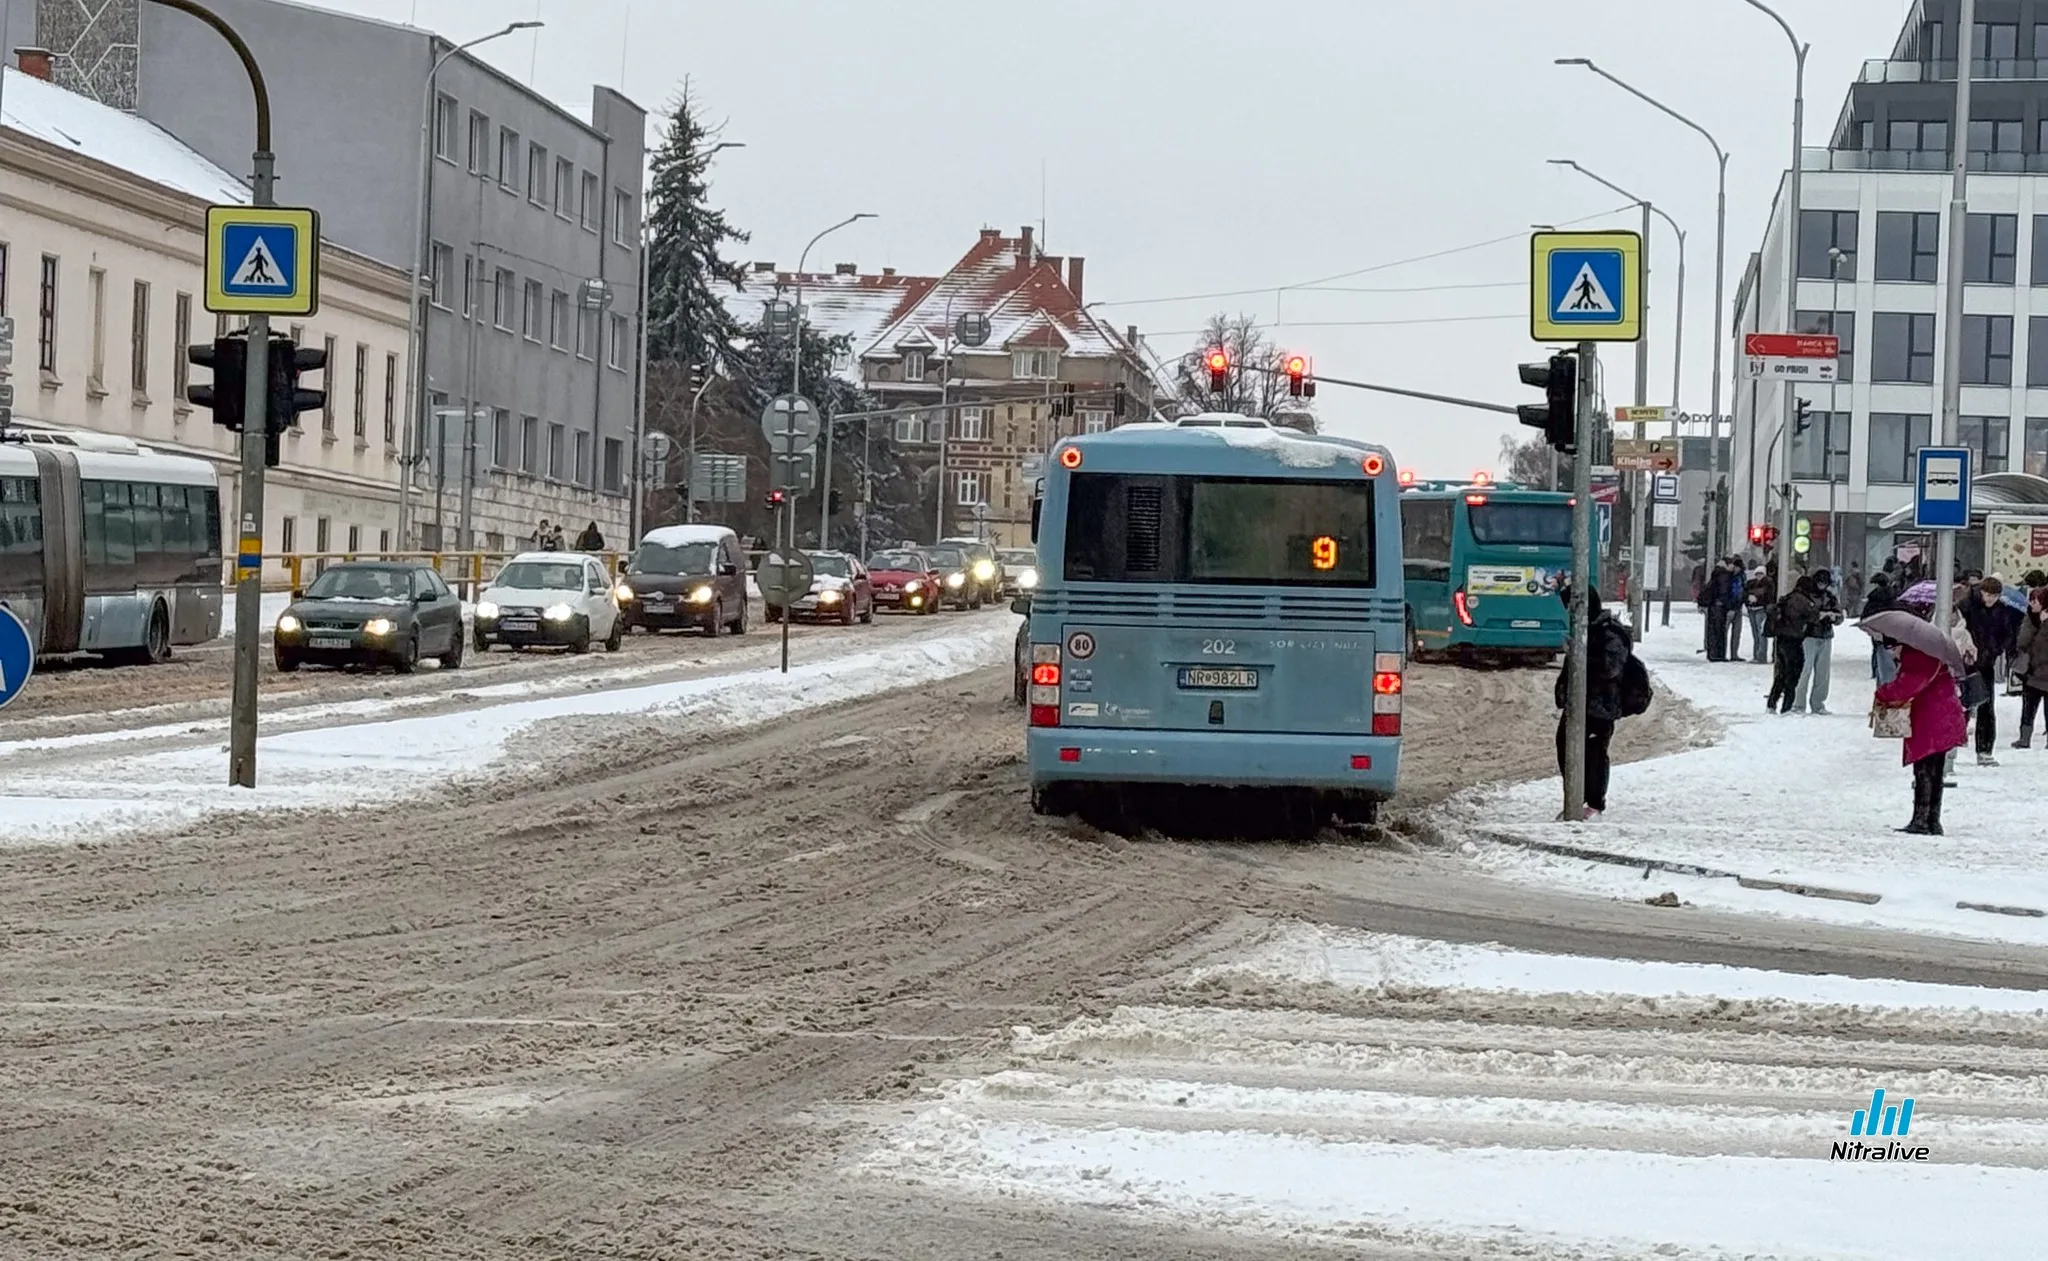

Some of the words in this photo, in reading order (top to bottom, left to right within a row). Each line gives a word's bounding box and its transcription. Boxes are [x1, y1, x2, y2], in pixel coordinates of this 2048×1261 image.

[1313, 536, 1336, 569] 9
[1074, 639, 1090, 650] 80
[1202, 639, 1236, 654] 202
